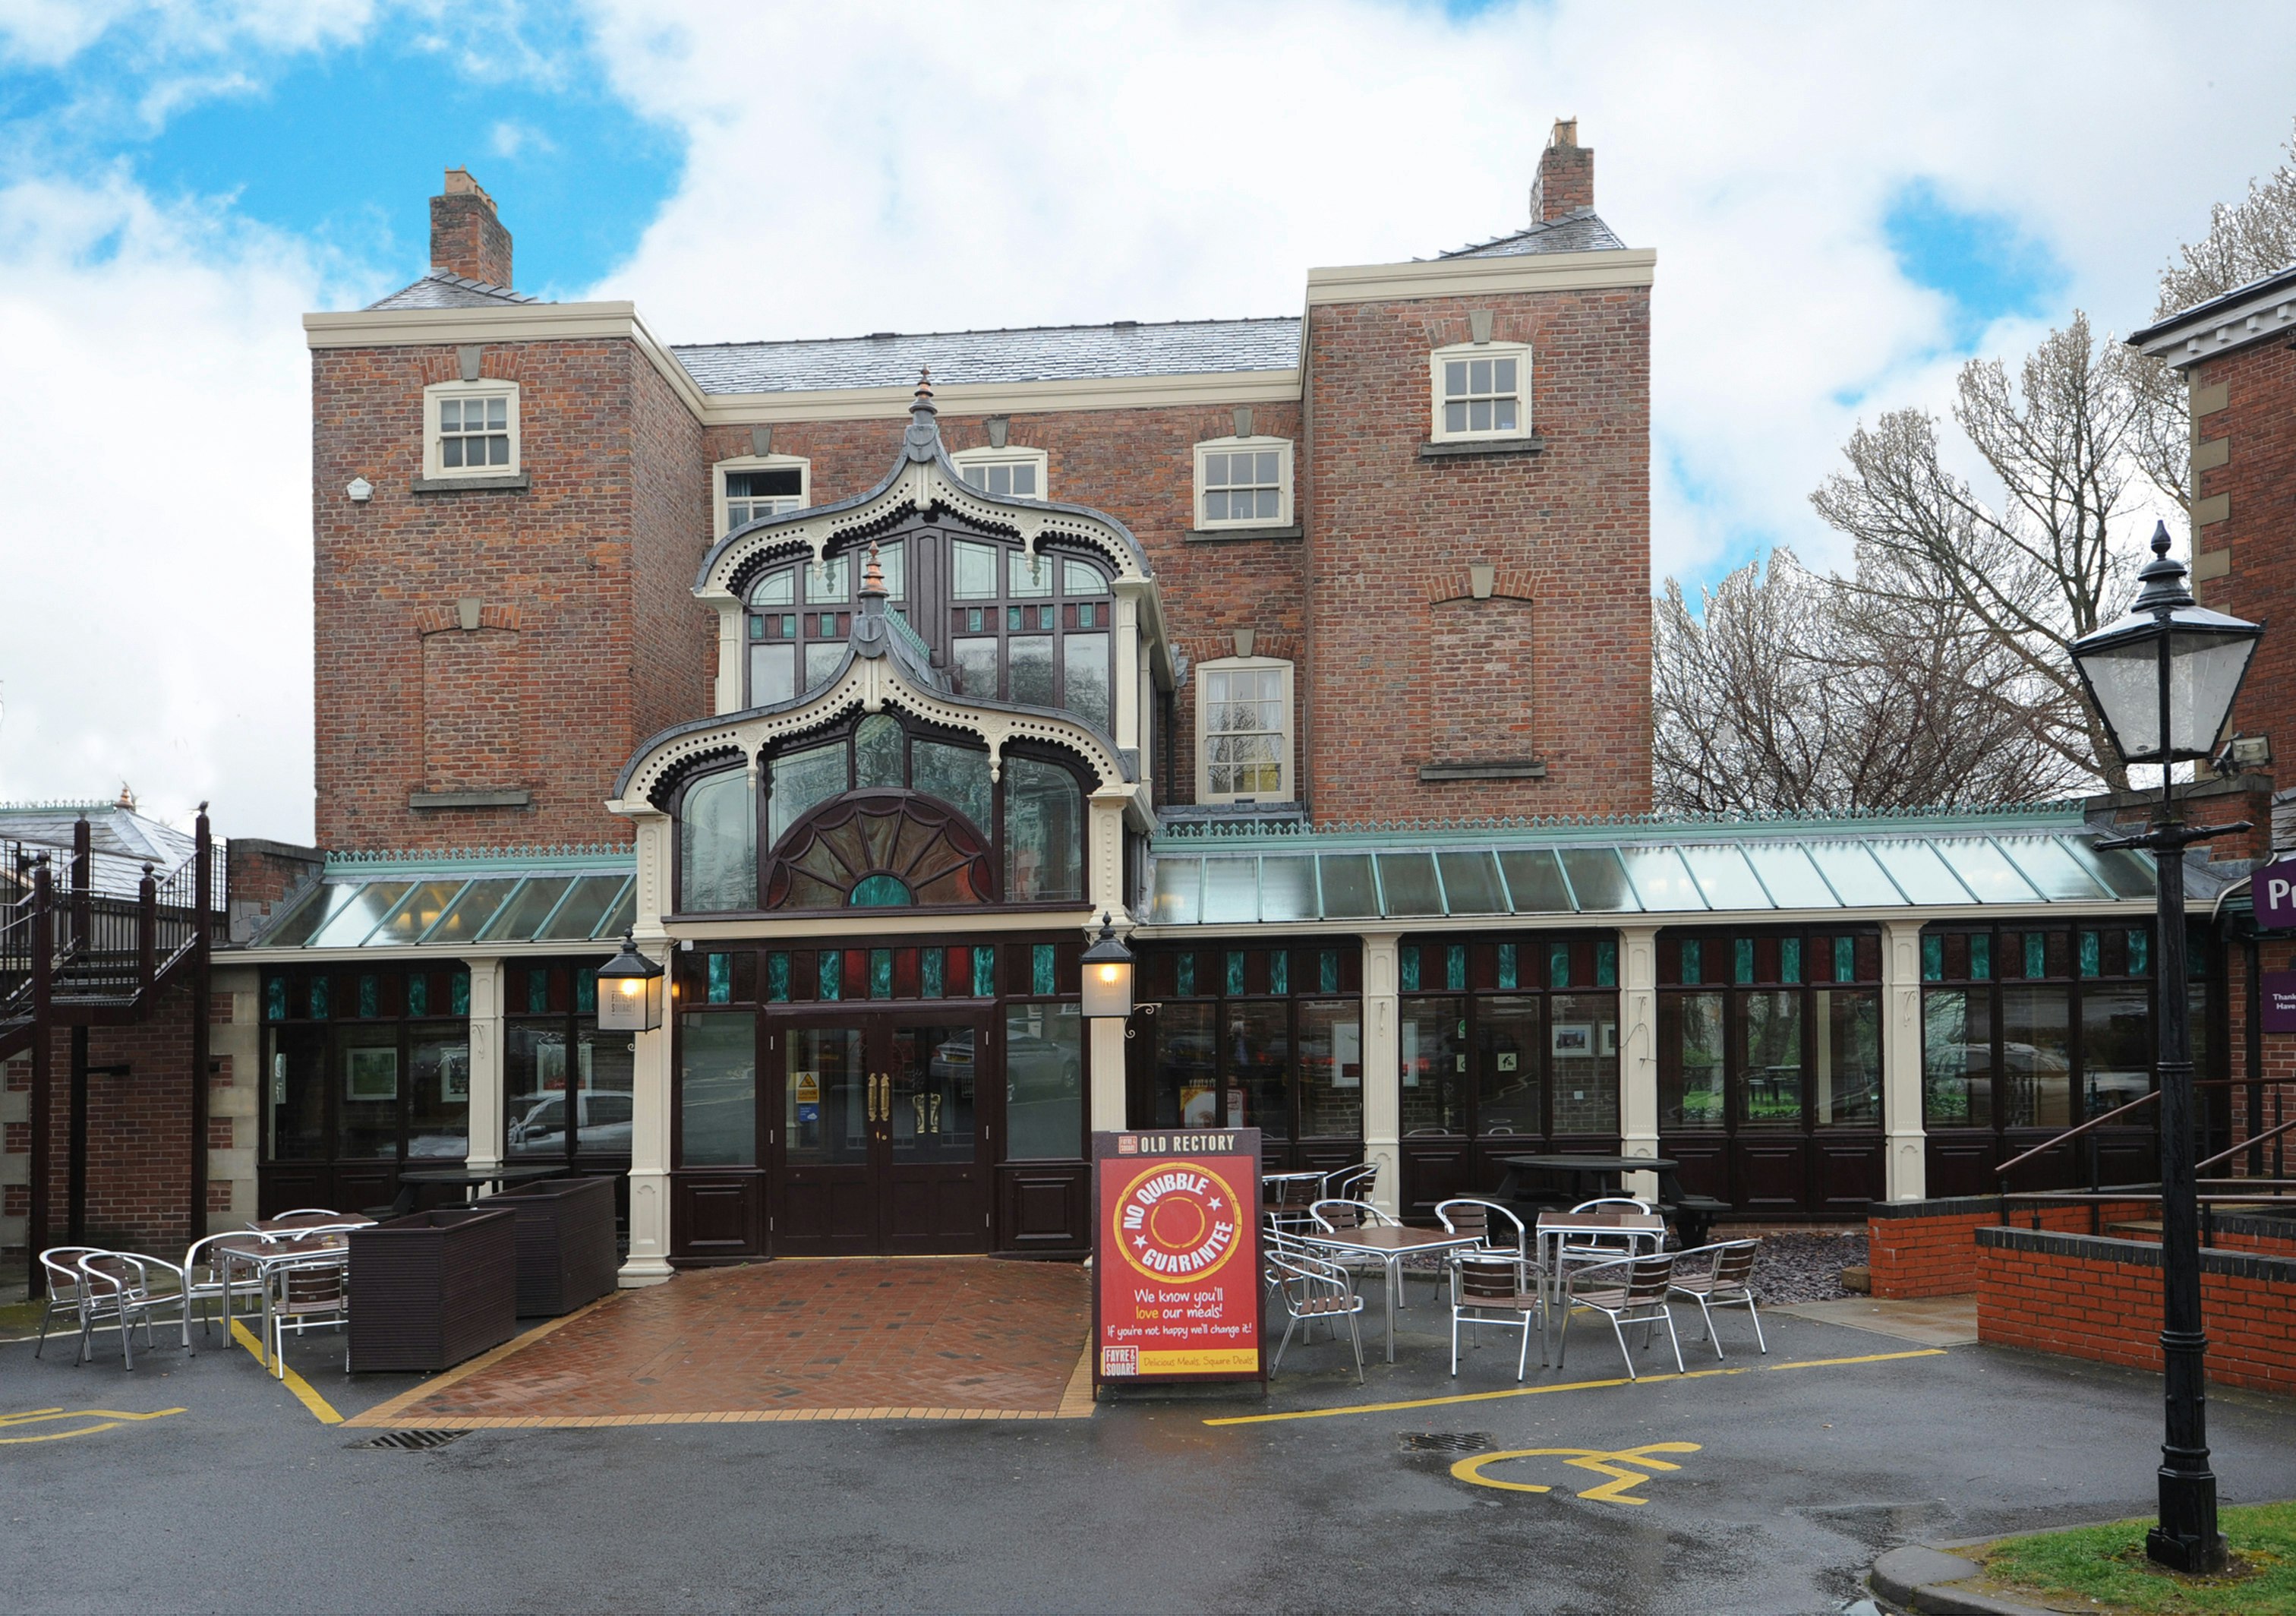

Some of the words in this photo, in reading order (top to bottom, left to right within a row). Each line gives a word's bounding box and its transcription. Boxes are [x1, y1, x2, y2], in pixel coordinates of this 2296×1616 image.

[1141, 1136, 1166, 1153] OLD
[1173, 1135, 1235, 1152] RECTORY
[1123, 1204, 1145, 1229] NO
[1136, 1173, 1210, 1205] QUIBBLE
[1142, 1220, 1234, 1273] GUARANTEE
[1134, 1288, 1156, 1303] We
[1159, 1289, 1190, 1302] know
[1194, 1286, 1223, 1308] you'll
[1136, 1305, 1159, 1319] love
[1162, 1308, 1184, 1319] our
[1187, 1303, 1222, 1318] meals!
[1107, 1325, 1115, 1338] If
[1145, 1326, 1160, 1336] not
[1162, 1325, 1188, 1340] happy
[1210, 1324, 1240, 1339] change
[1241, 1322, 1252, 1333] it!
[1105, 1349, 1130, 1362] FAYRE
[1130, 1349, 1135, 1362] &
[1143, 1357, 1175, 1367] Delicious
[1203, 1356, 1231, 1367] Square
[1105, 1363, 1135, 1376] SQUARE
